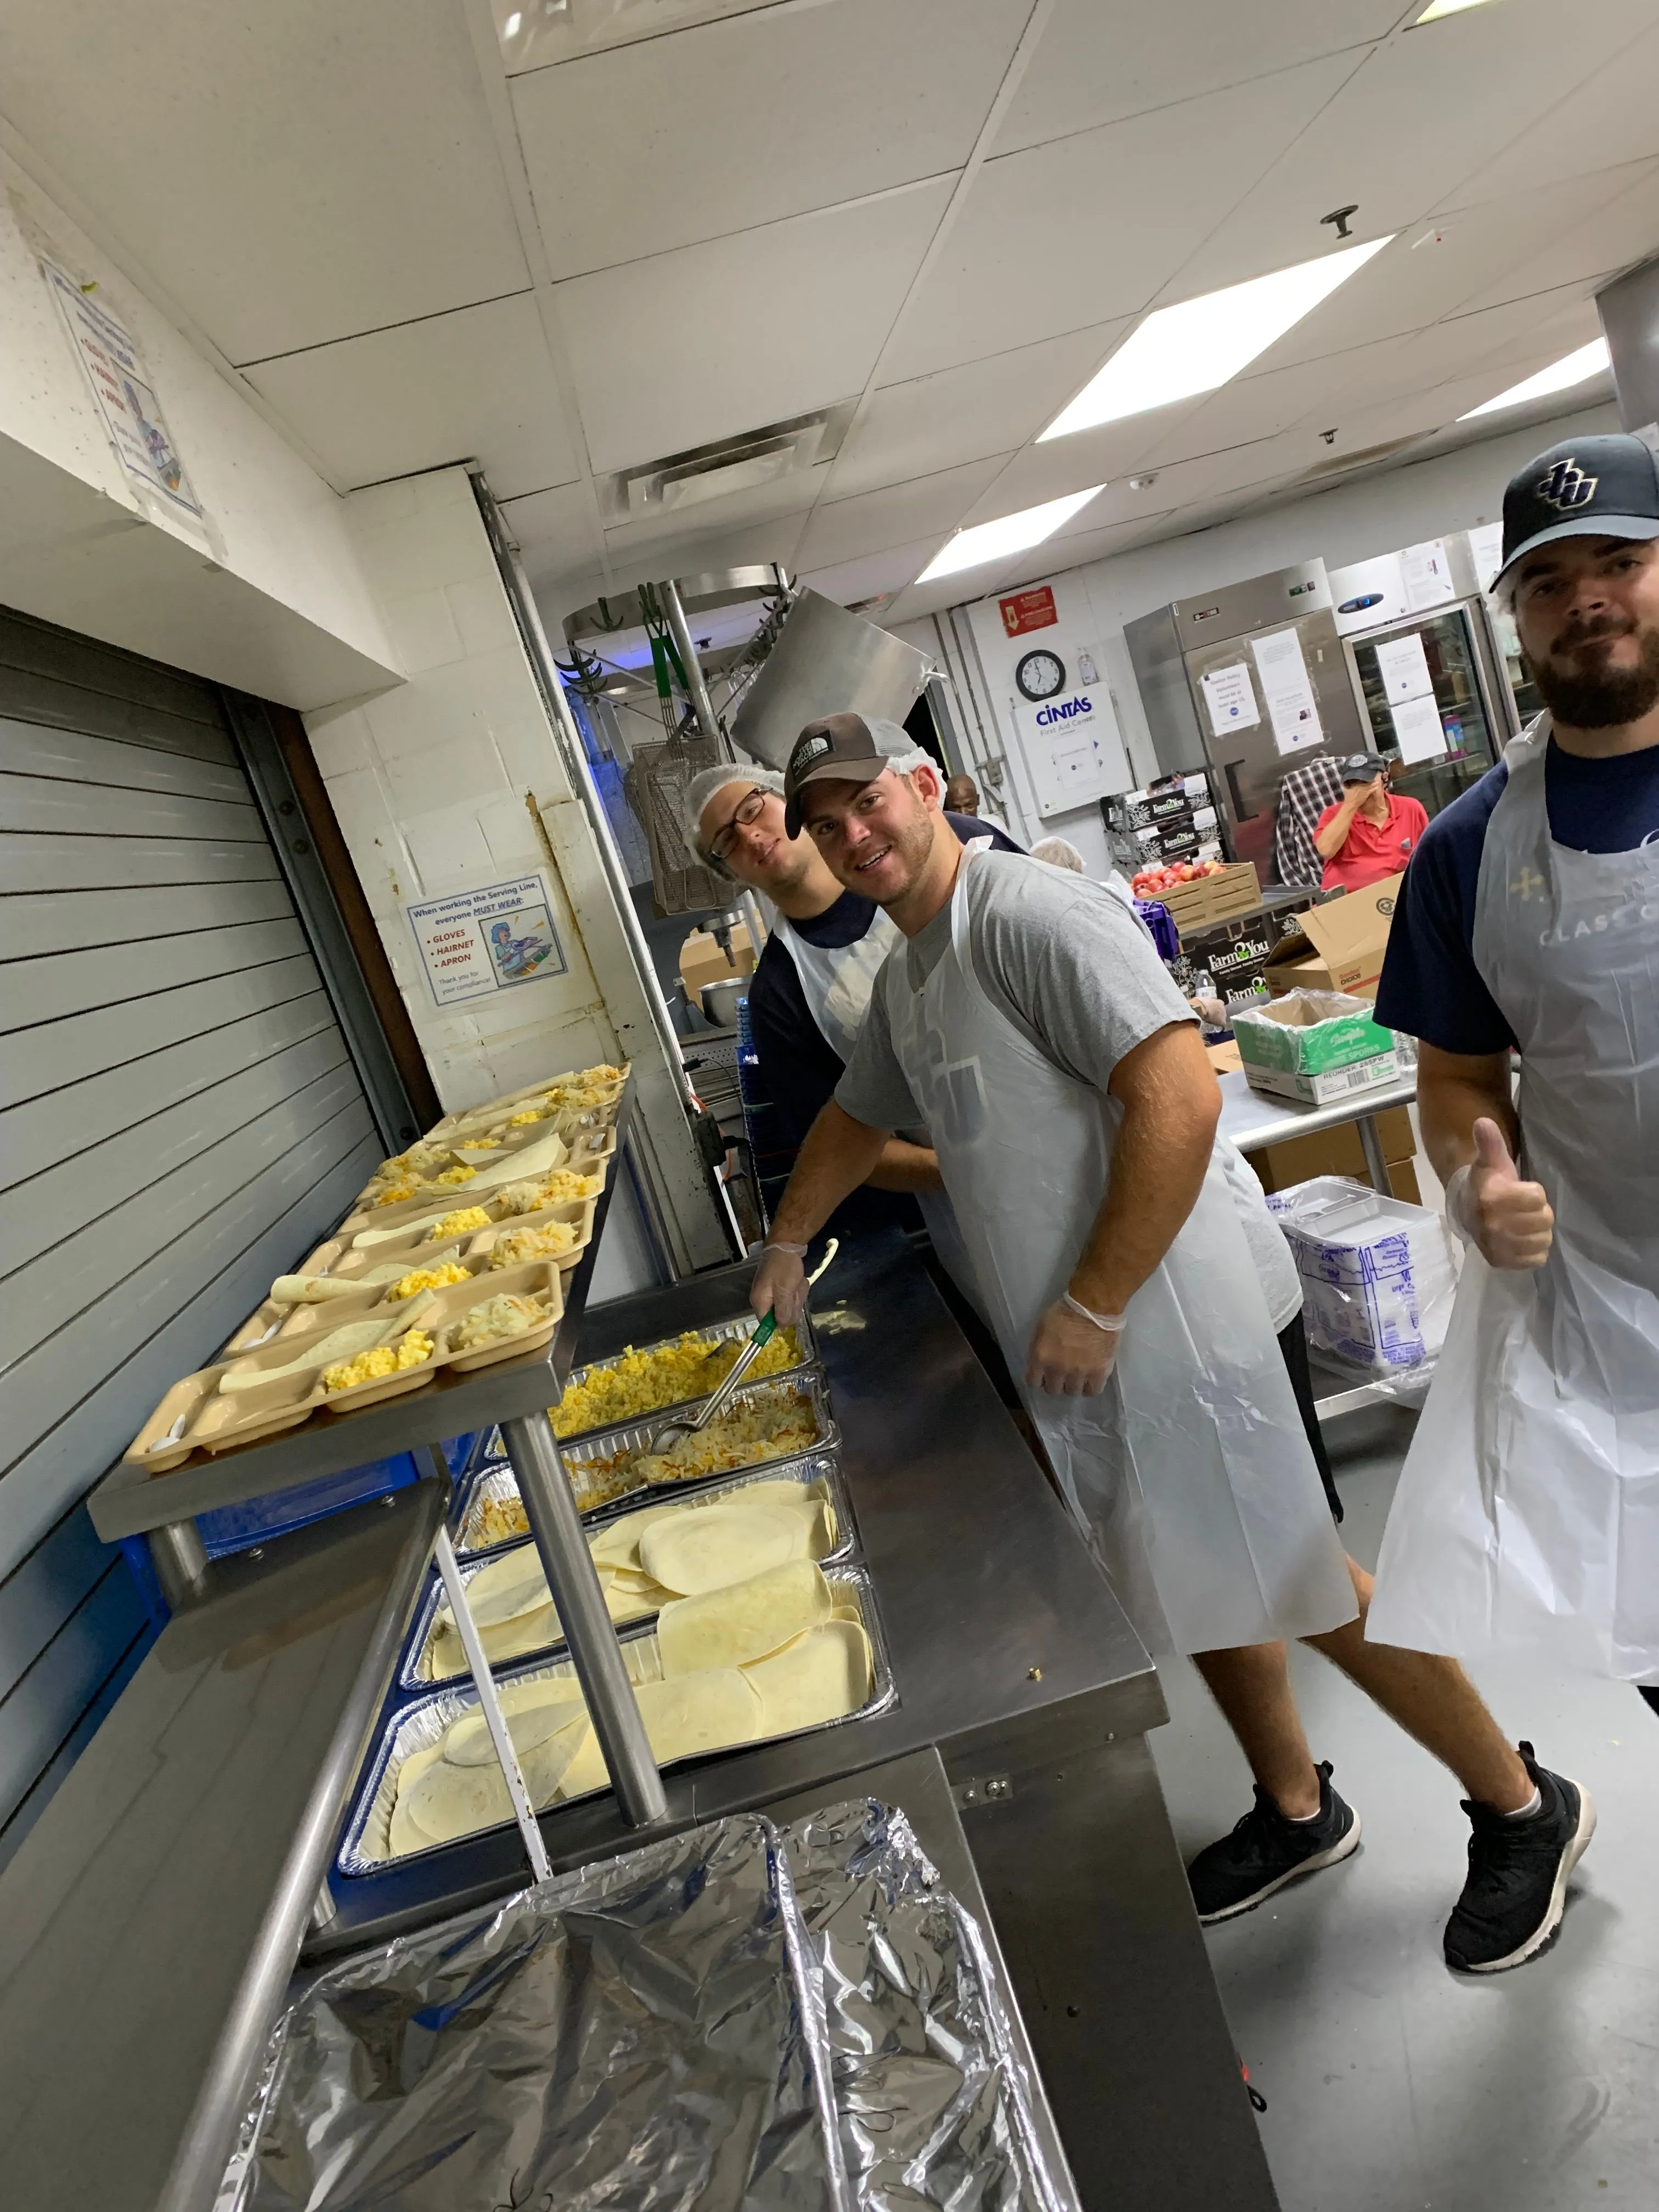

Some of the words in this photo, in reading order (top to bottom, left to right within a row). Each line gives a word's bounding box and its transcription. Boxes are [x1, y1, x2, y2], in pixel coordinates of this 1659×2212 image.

[1040, 727, 1056, 737] First
[1059, 722, 1070, 731] Aid
[1072, 715, 1096, 726] Center
[413, 908, 438, 918] When
[439, 898, 472, 912] working
[473, 894, 486, 902] the
[487, 887, 518, 899] Serving
[435, 911, 472, 925] everyone
[473, 904, 495, 916] MUST
[497, 898, 524, 910] WEAR:
[433, 929, 465, 943] GLOVES
[437, 940, 474, 955] HAIRNET
[441, 953, 471, 967] APRON
[439, 977, 457, 985] Thank
[442, 988, 455, 996] your
[1348, 1044, 1380, 1060] SPORKS
